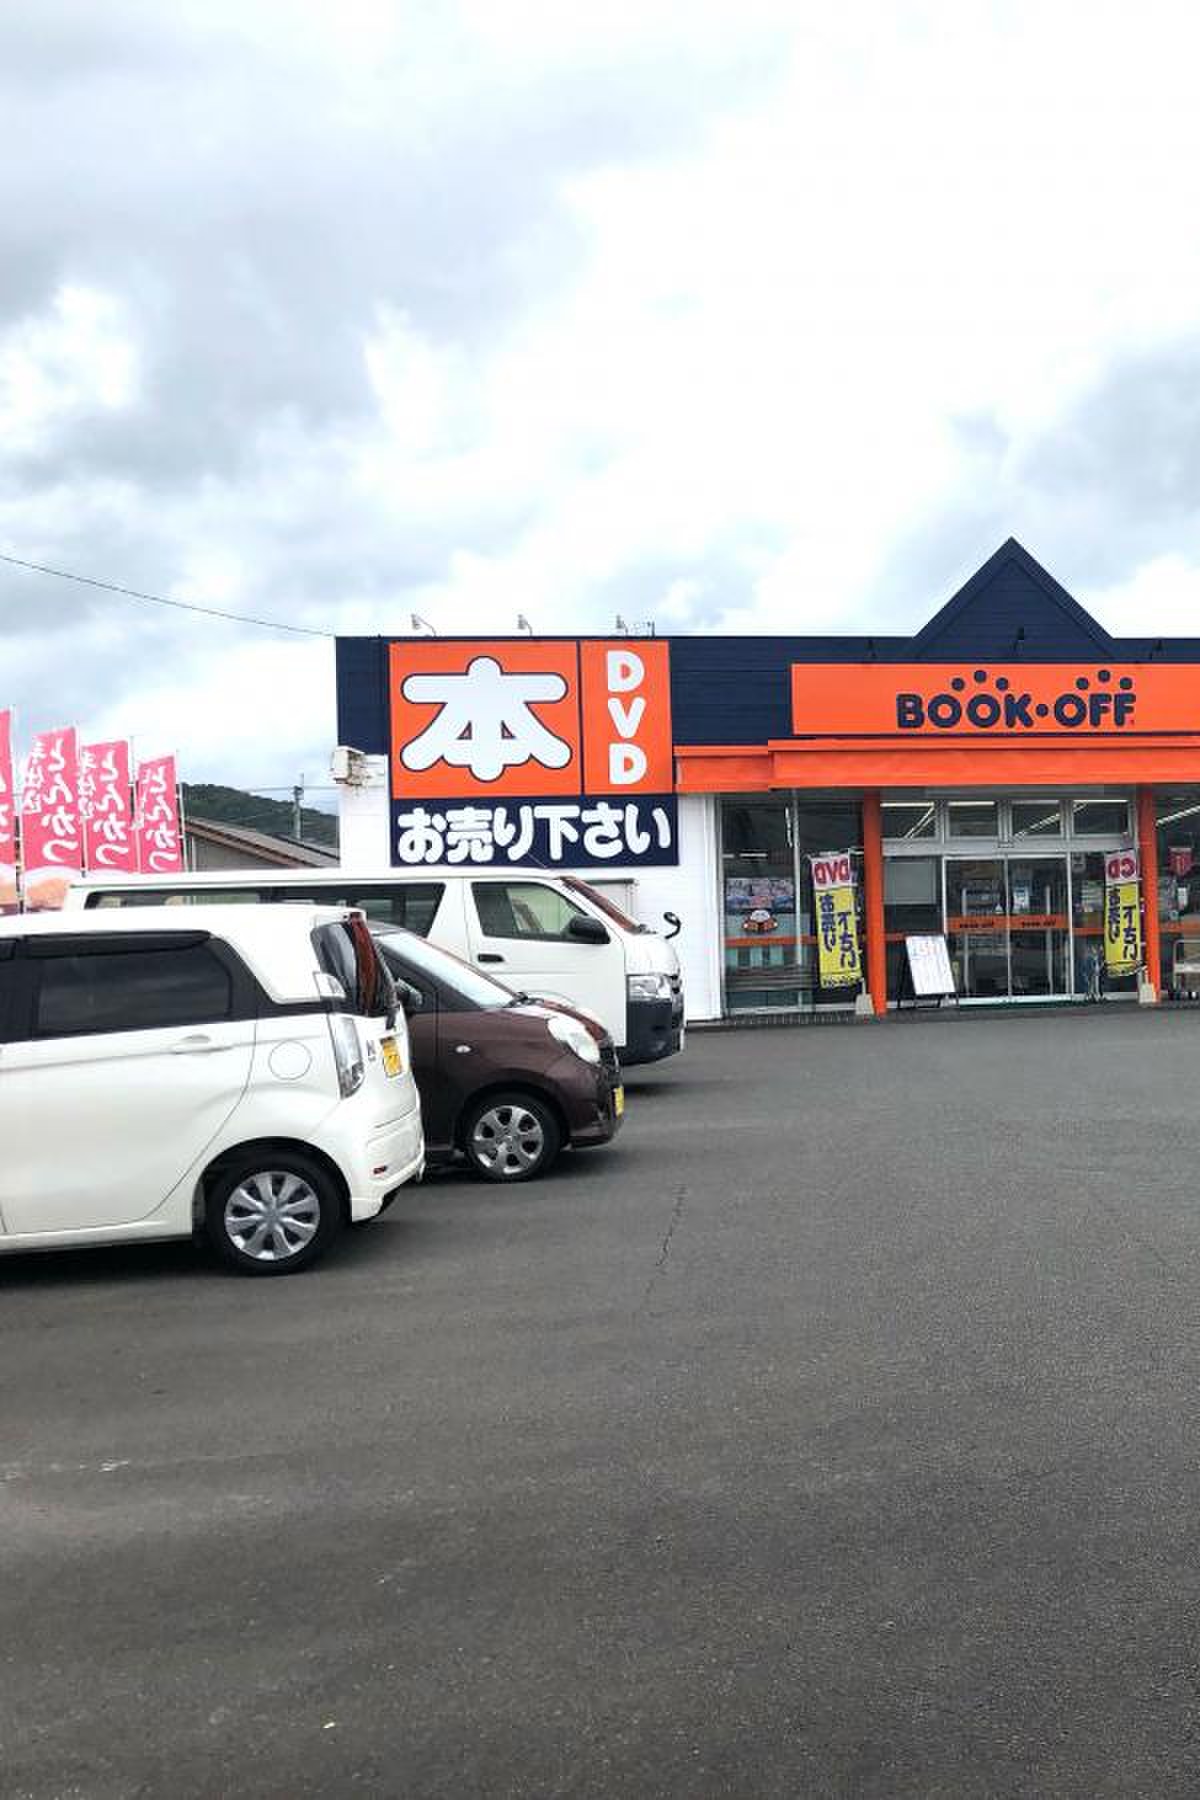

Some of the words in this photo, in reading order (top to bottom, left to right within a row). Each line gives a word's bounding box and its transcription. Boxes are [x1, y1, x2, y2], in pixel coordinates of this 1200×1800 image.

[400, 656, 572, 782] 本
[607, 650, 648, 785] DVD
[398, 802, 671, 863] お売り下さい
